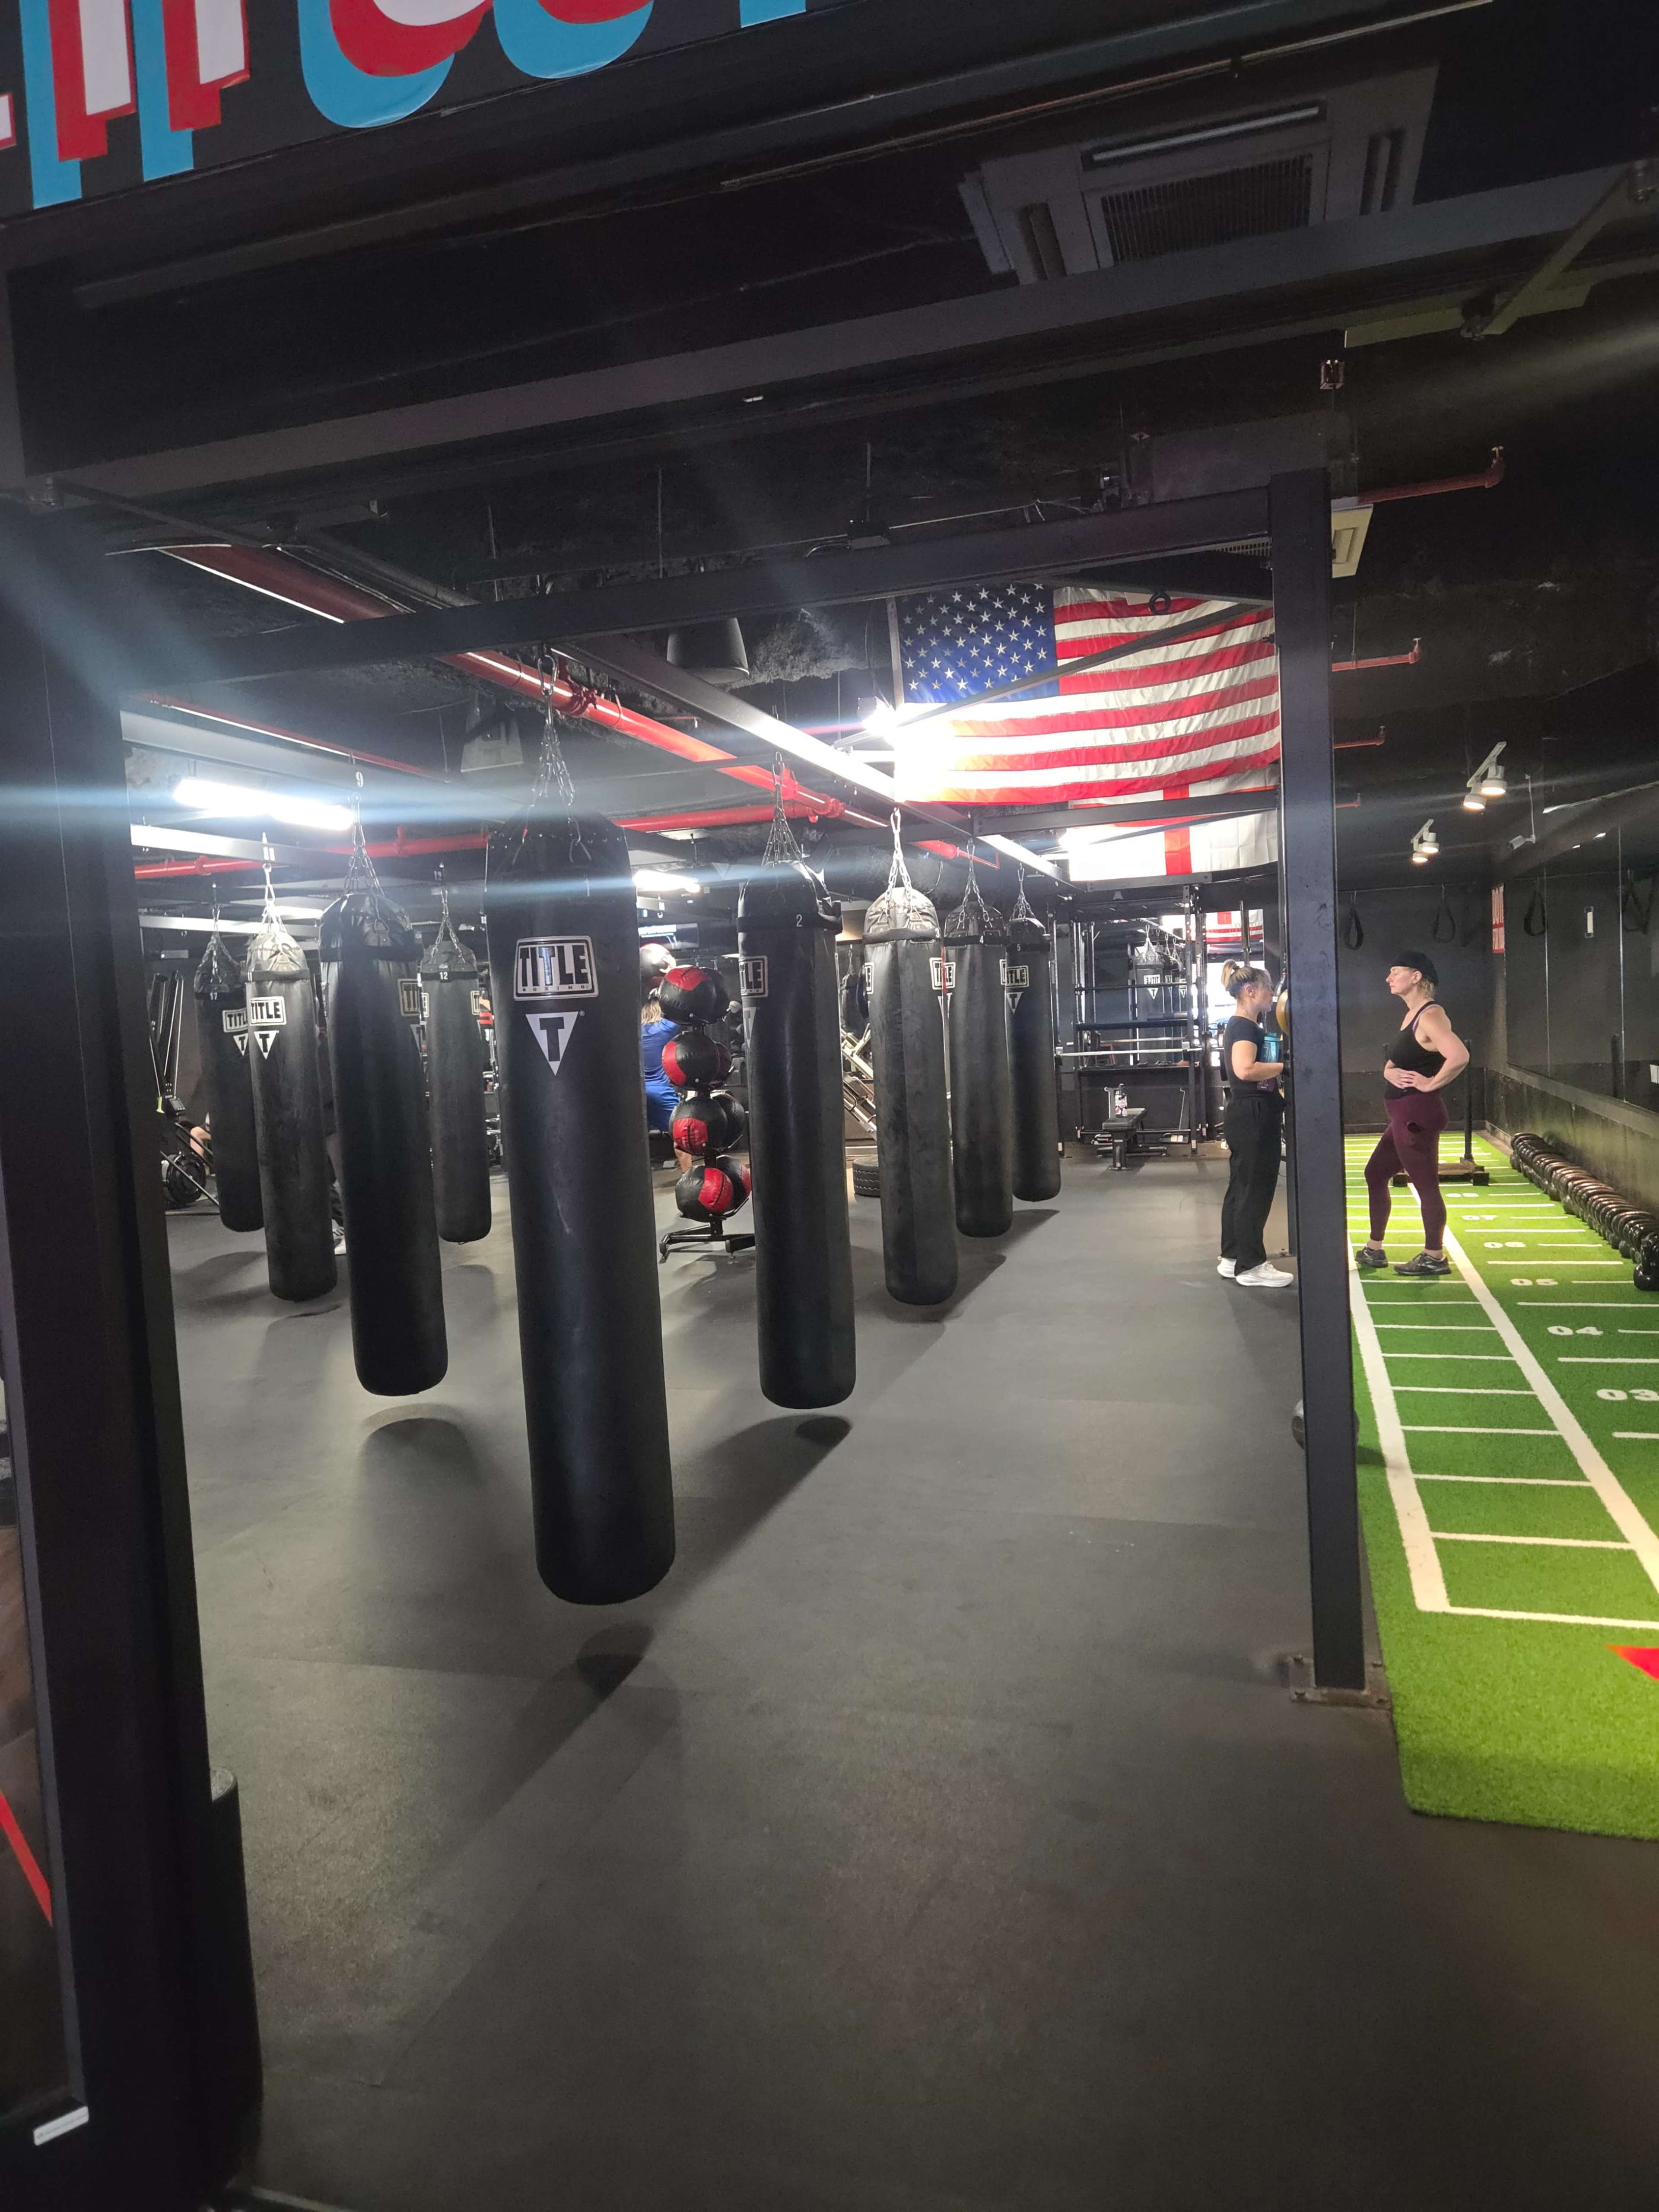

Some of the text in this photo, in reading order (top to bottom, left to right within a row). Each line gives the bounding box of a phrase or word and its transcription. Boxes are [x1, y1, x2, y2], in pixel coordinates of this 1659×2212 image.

[796, 914, 802, 927] 2
[935, 928, 940, 938] 3
[979, 935, 984, 944] 4
[520, 945, 589, 987] TITLE
[439, 972, 448, 980] 12
[1006, 969, 1026, 984] ITLE
[1009, 994, 1017, 1009] T
[251, 1002, 281, 1019] TITLE
[227, 1011, 248, 1027] TITL
[239, 1036, 246, 1051] T
[259, 1033, 270, 1053] T
[539, 1017, 564, 1062] T
[1547, 1325, 1604, 1335] 04
[1596, 1389, 1659, 1401] 03
